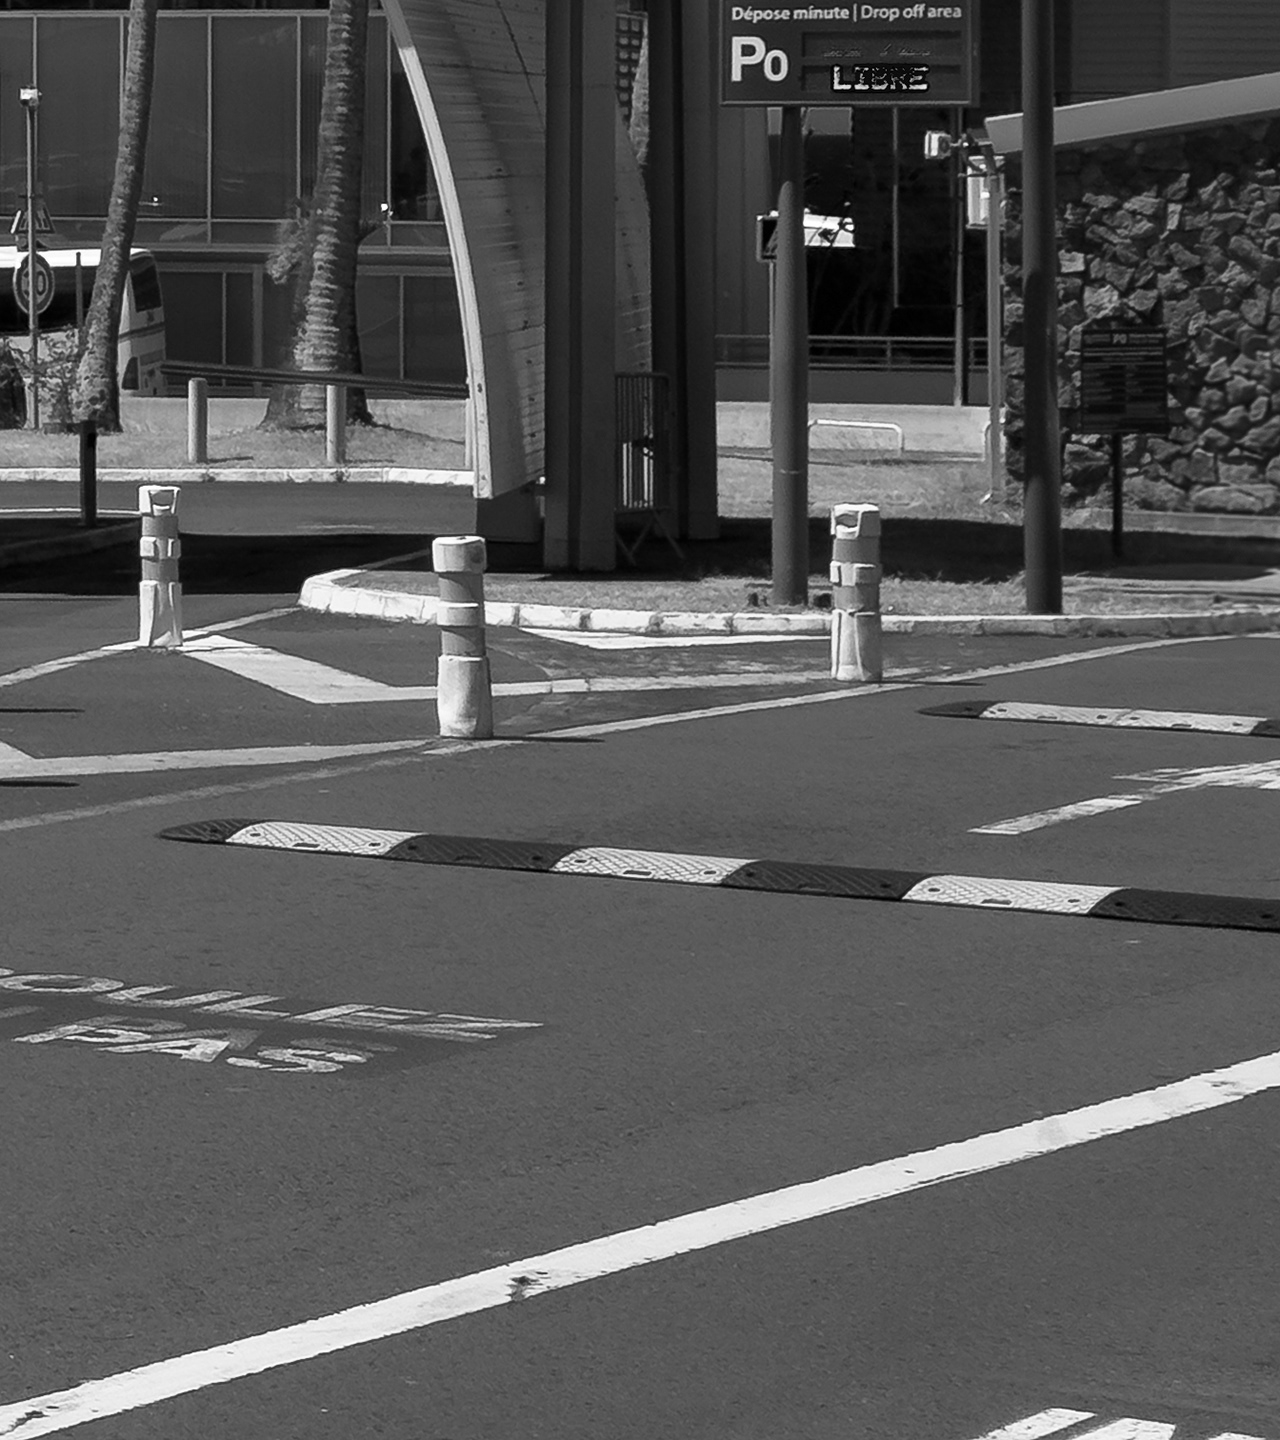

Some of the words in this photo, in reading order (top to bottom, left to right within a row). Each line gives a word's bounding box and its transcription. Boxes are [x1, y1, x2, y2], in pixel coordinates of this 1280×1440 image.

[731, 5, 791, 24] Dépose
[793, 4, 850, 20] minute
[860, 4, 900, 23] Drop
[902, 3, 925, 19] off
[927, 5, 962, 19] area
[831, 65, 930, 91] LIBRE
[11, 1015, 399, 1076] PAS
